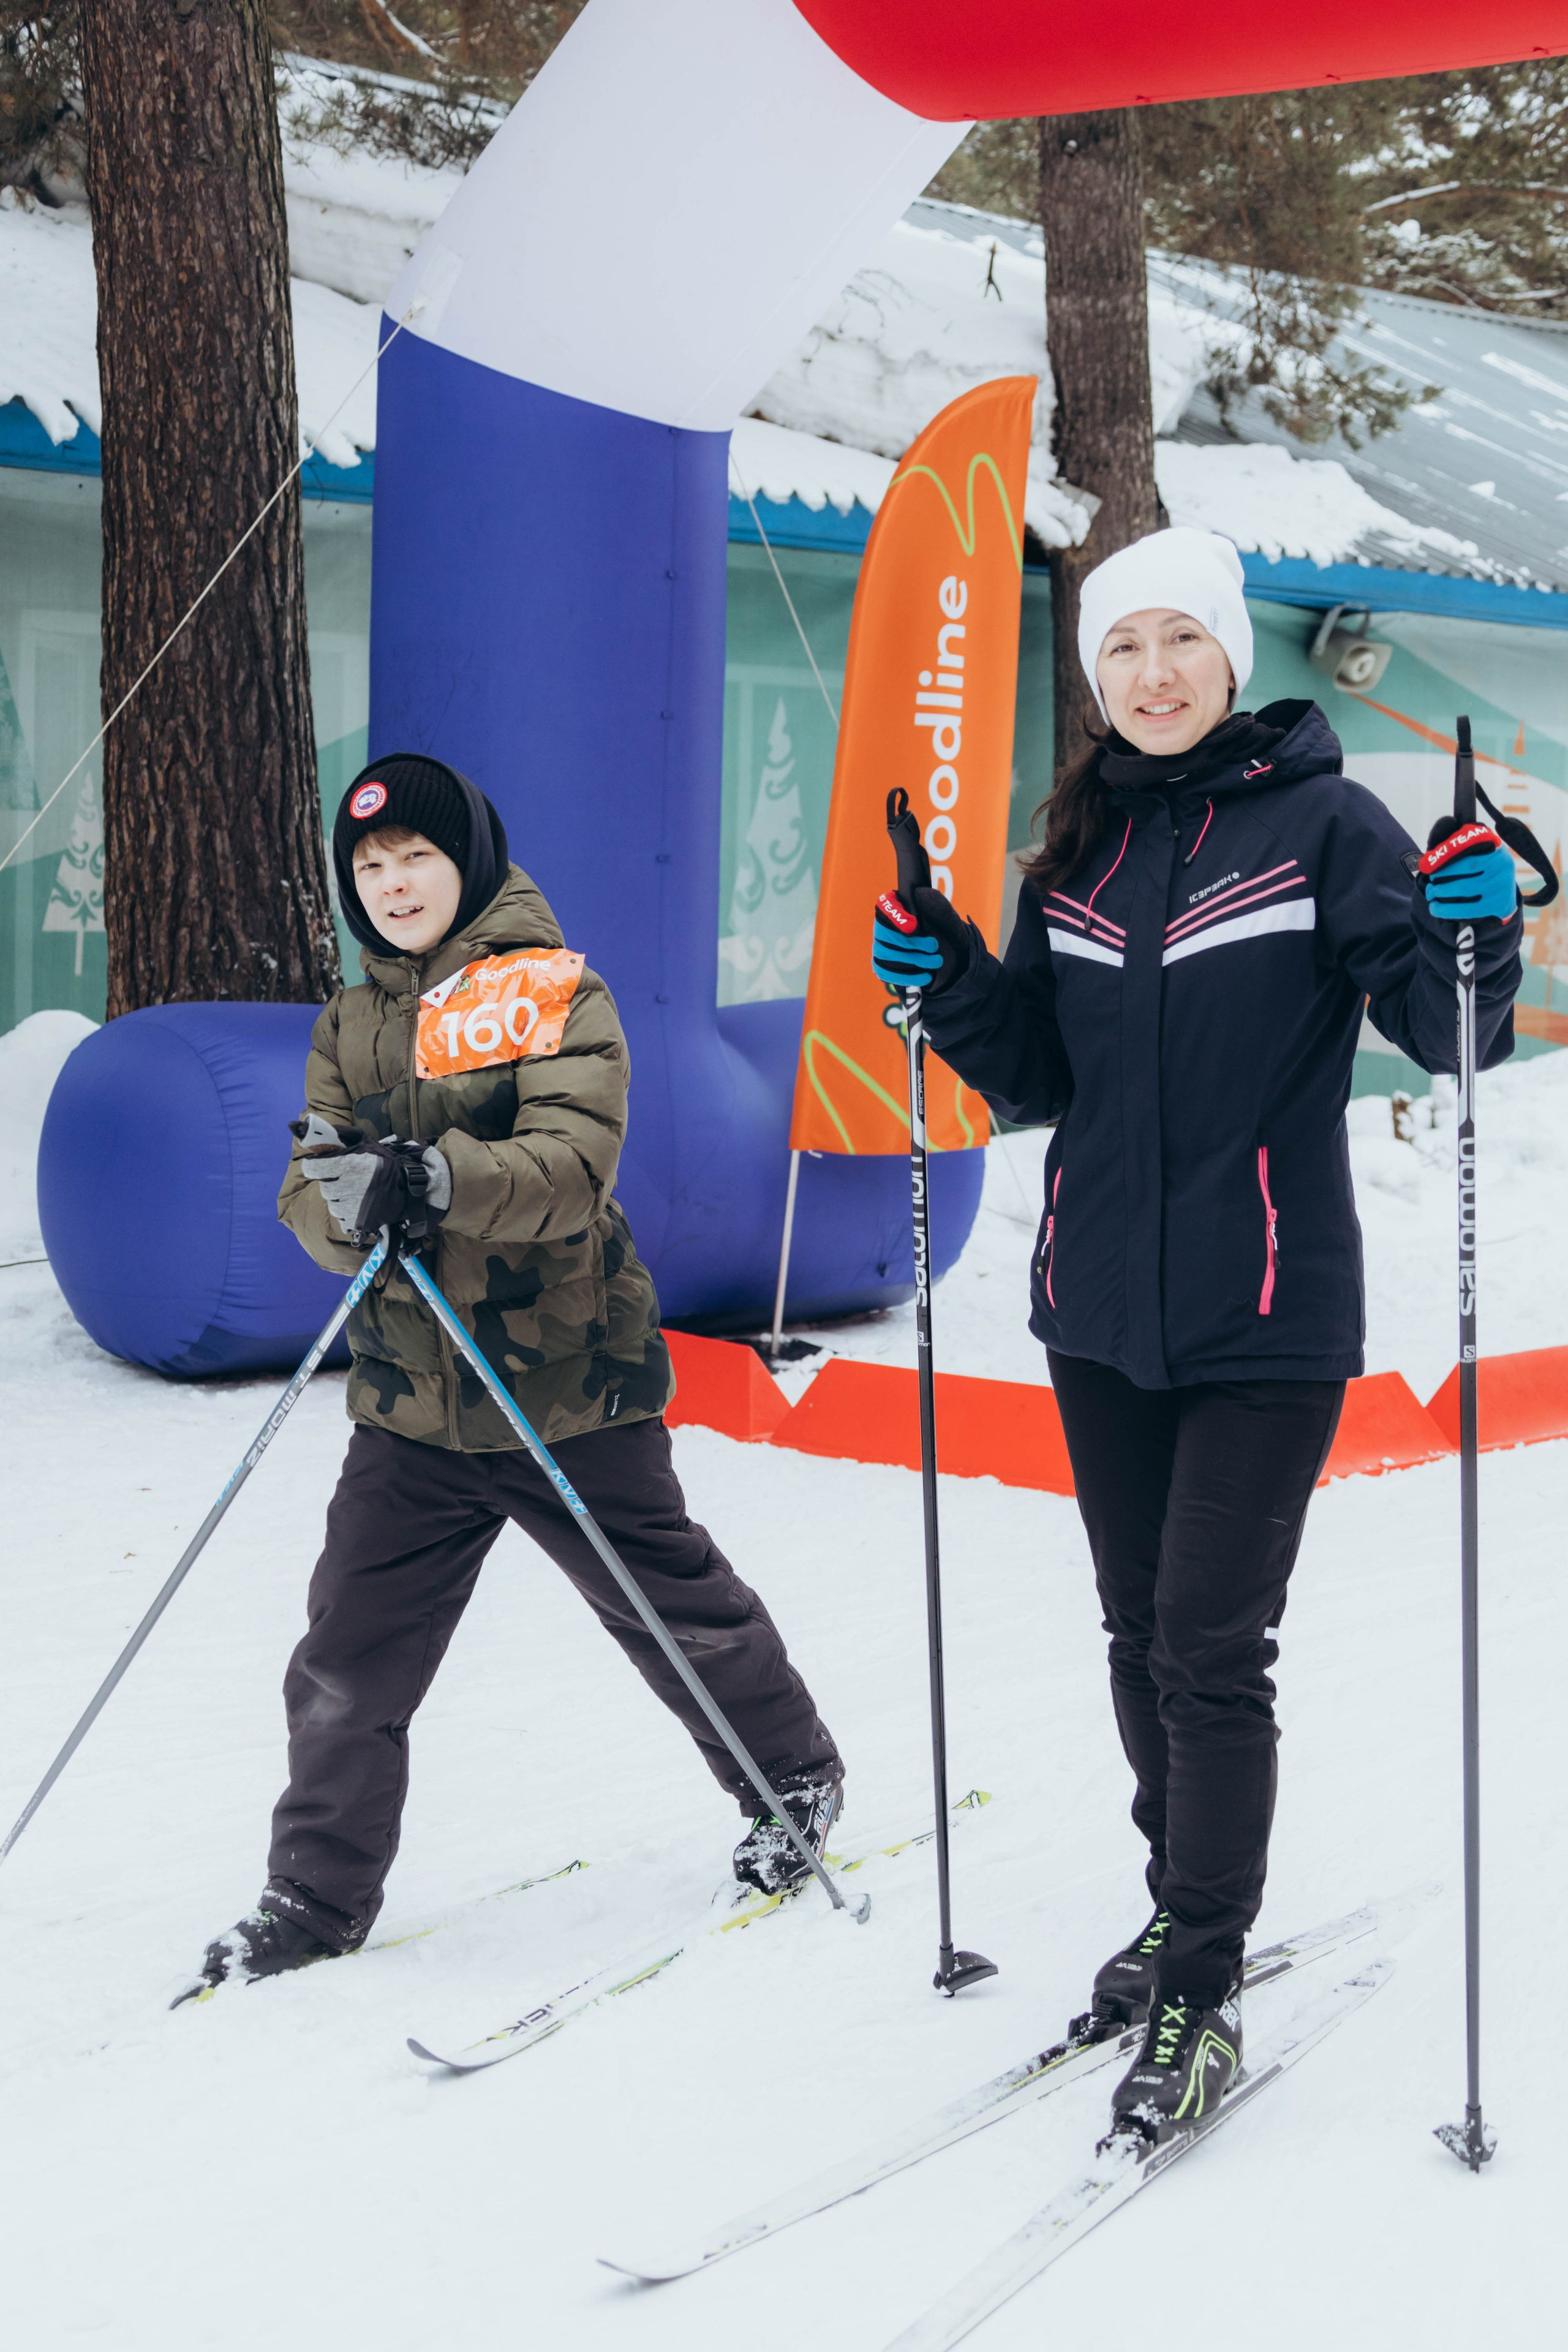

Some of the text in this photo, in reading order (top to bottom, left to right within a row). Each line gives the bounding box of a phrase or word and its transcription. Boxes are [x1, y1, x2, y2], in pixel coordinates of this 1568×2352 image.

[1428, 845, 1447, 865] SKI
[1450, 826, 1488, 847] TEAM
[882, 900, 908, 925] TEAM
[475, 957, 552, 981] Goodline
[441, 997, 540, 1058] 160
[1459, 1137, 1476, 1316] salomon
[1214, 2000, 1240, 2032] REK
